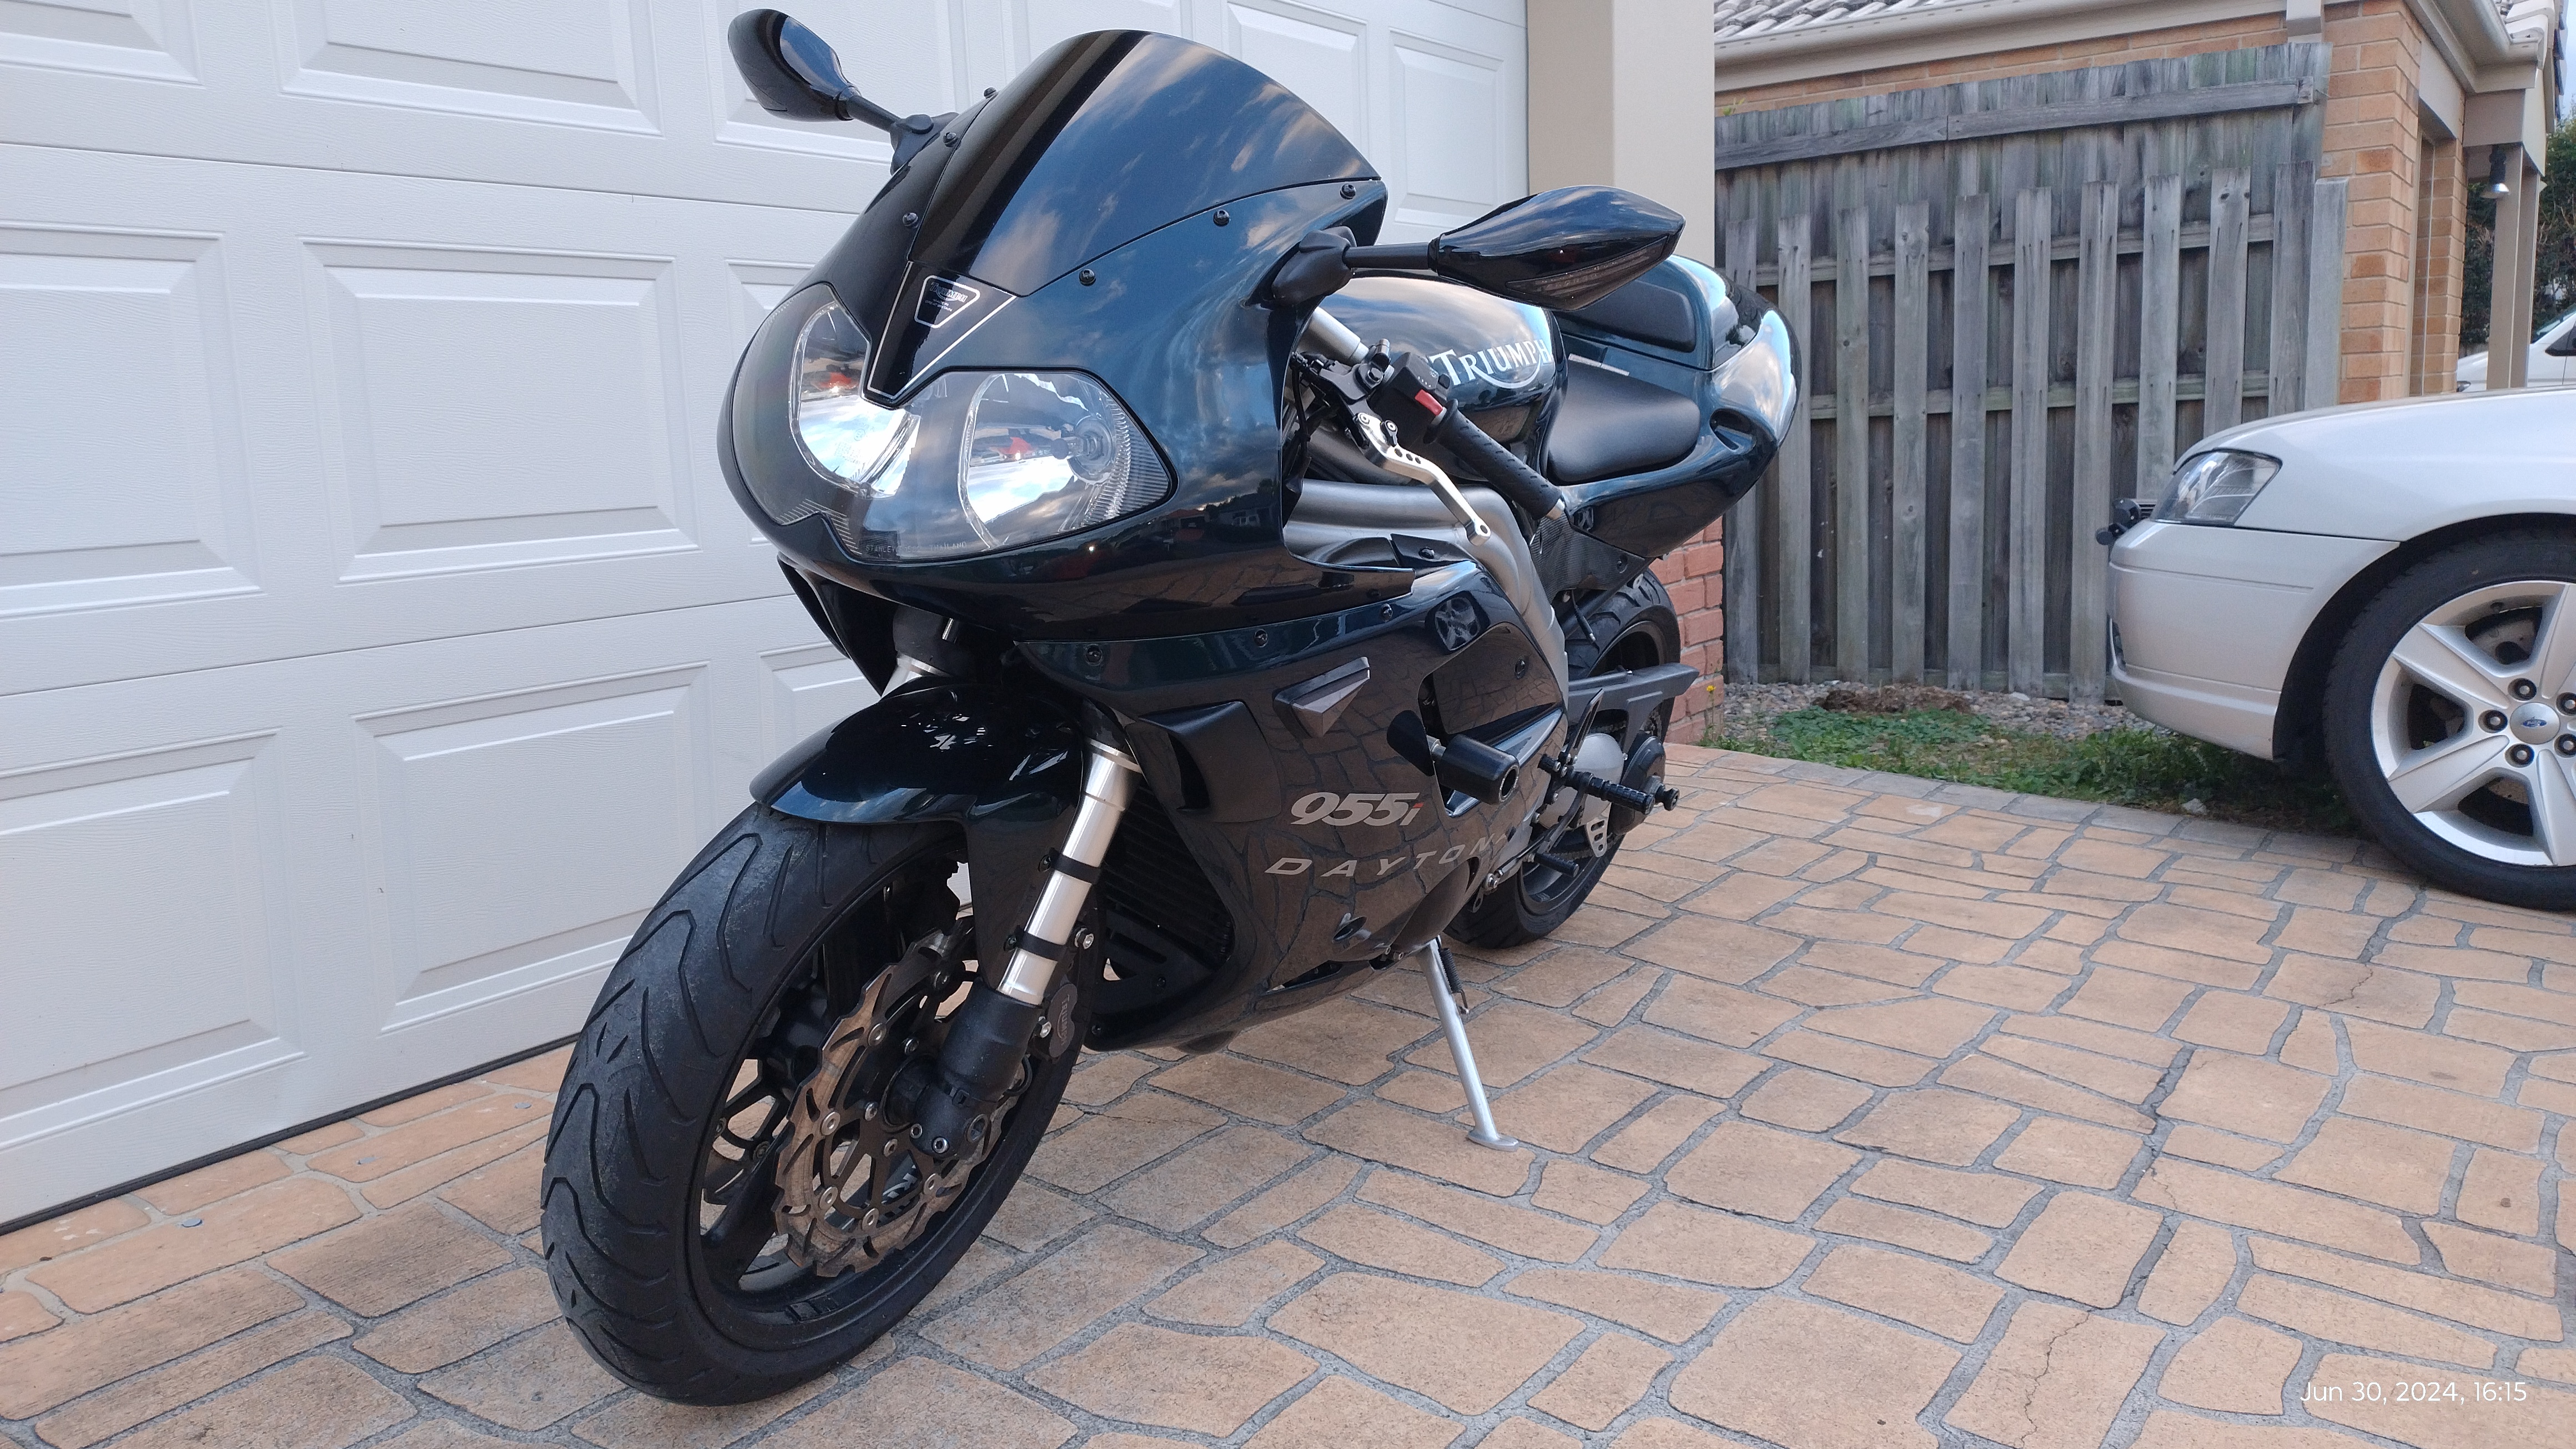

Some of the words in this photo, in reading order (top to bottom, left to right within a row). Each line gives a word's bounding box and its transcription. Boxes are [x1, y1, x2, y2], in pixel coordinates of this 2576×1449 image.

[929, 281, 968, 303] TRIUMPH
[1430, 339, 1553, 389] TRIUMPH
[1291, 792, 1424, 826] 955i
[1057, 994, 1070, 1046] TRIUMPH
